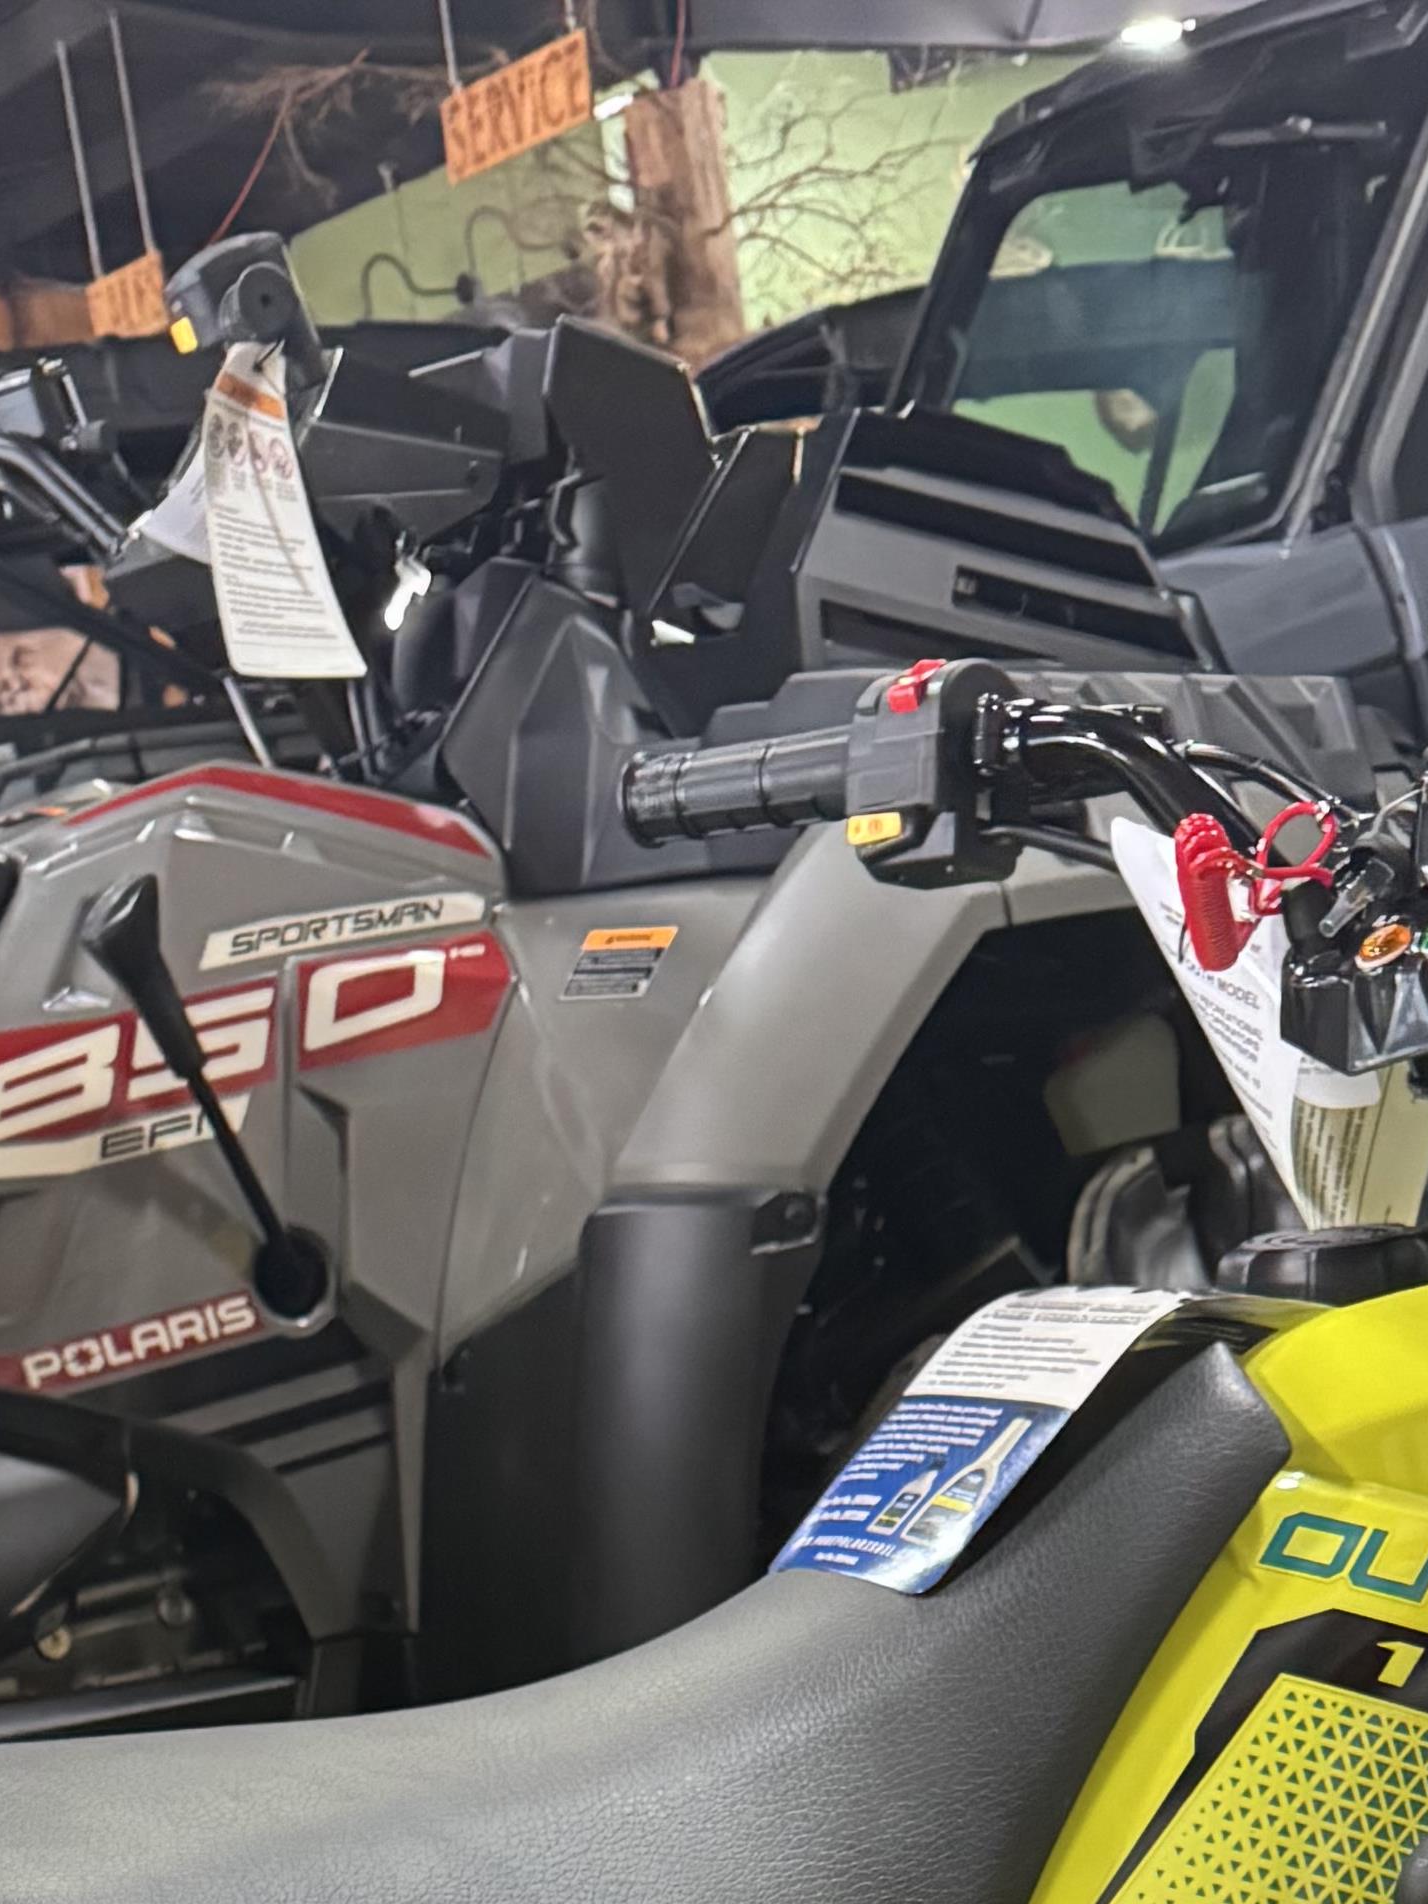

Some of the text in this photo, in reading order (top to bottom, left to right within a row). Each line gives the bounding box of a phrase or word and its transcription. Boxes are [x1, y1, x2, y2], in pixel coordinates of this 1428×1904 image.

[449, 38, 587, 176] SERVICE
[230, 898, 444, 957] SPORTSMAN
[101, 1109, 206, 1158] EFI
[22, 1296, 257, 1391] POLARIS
